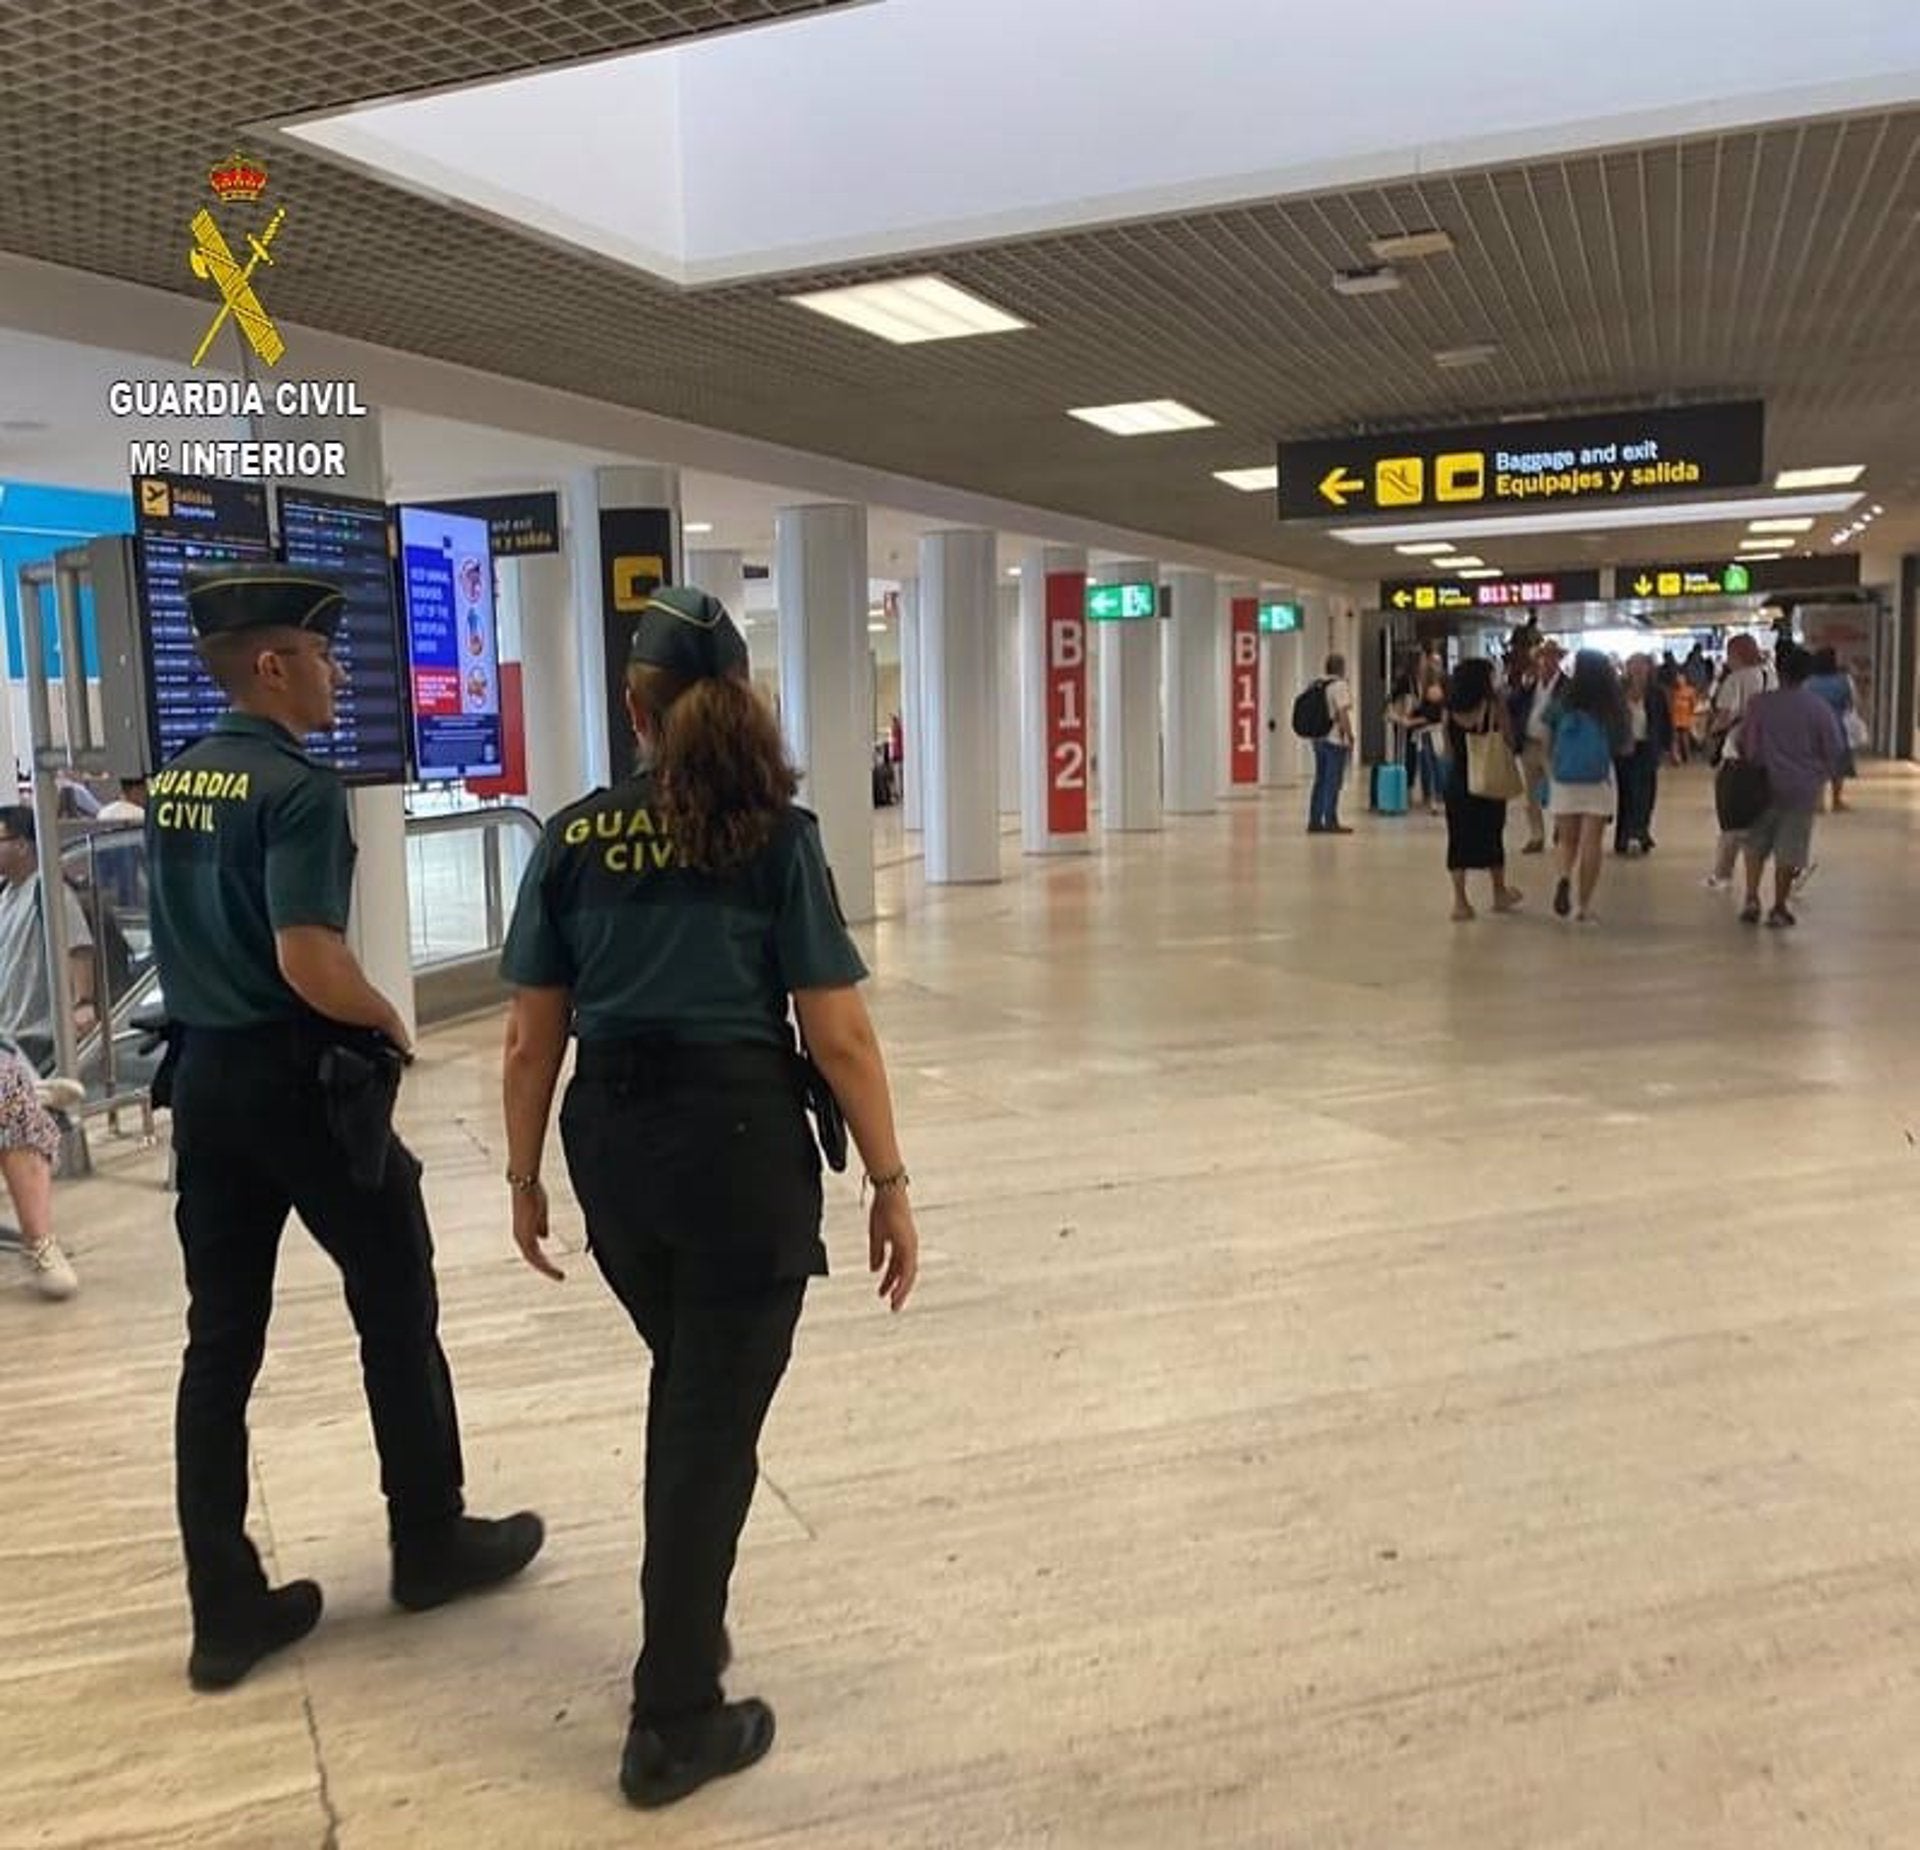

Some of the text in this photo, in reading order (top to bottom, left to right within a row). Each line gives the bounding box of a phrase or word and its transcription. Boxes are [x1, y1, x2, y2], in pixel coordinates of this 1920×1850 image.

[1496, 440, 1658, 472] Baggage and exit
[1496, 460, 1699, 498] Equipajes y salida
[1051, 619, 1084, 789] B12
[1235, 631, 1256, 753] B11
[158, 801, 214, 832] CIVIL
